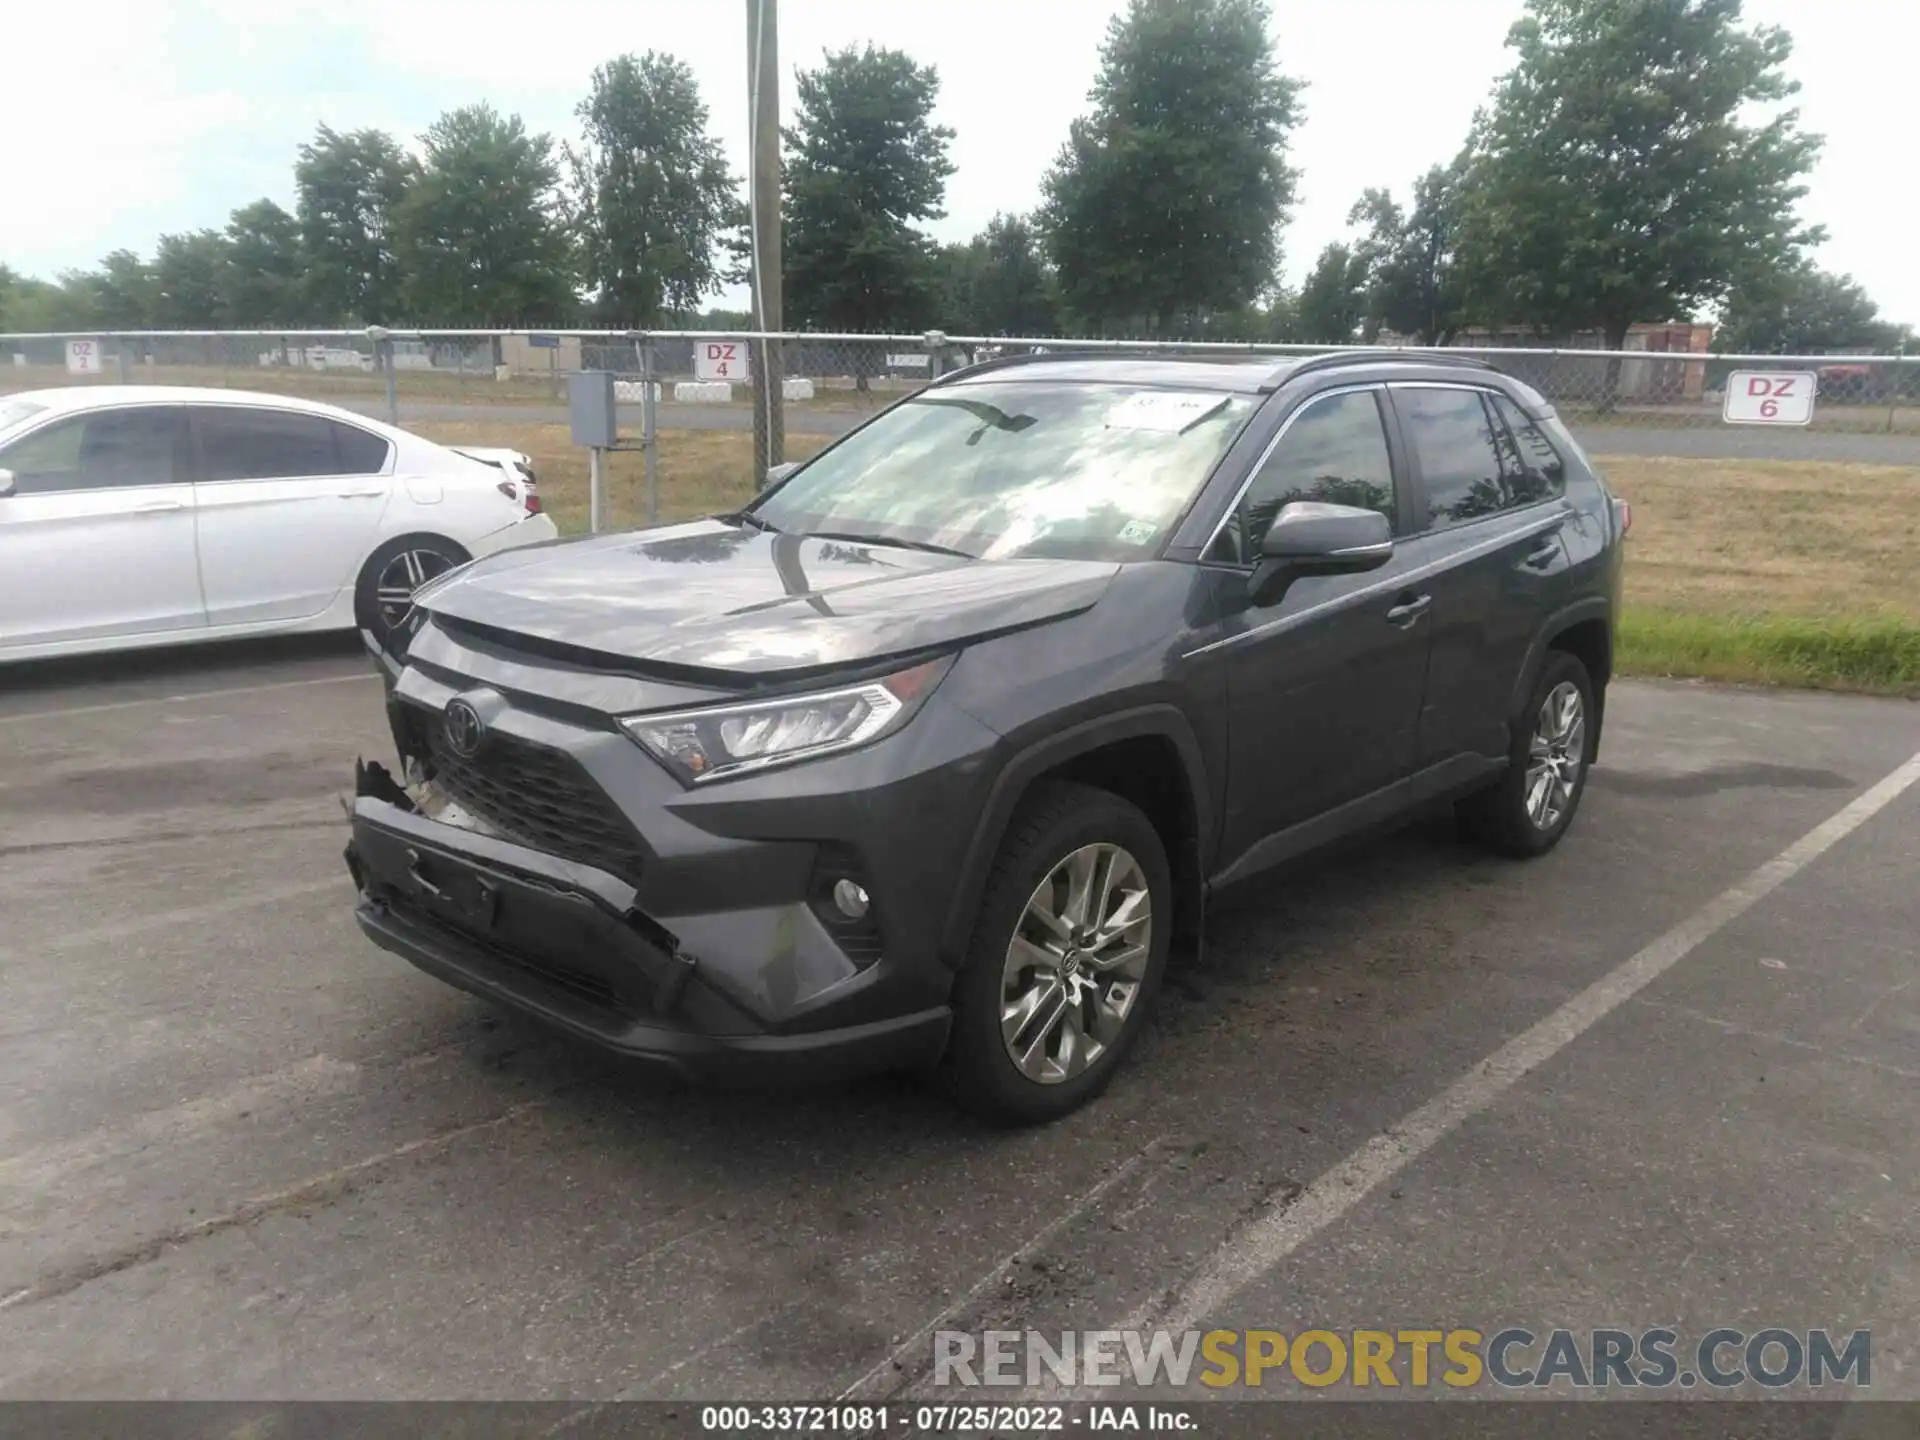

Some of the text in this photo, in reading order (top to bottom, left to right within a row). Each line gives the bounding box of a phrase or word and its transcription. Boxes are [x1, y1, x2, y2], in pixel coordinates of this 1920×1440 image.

[72, 343, 92, 356] DZ
[707, 344, 737, 360] DZ
[80, 356, 88, 369] 2
[716, 361, 729, 377] 4
[1746, 377, 1797, 397] DZ
[1759, 399, 1779, 418] 6
